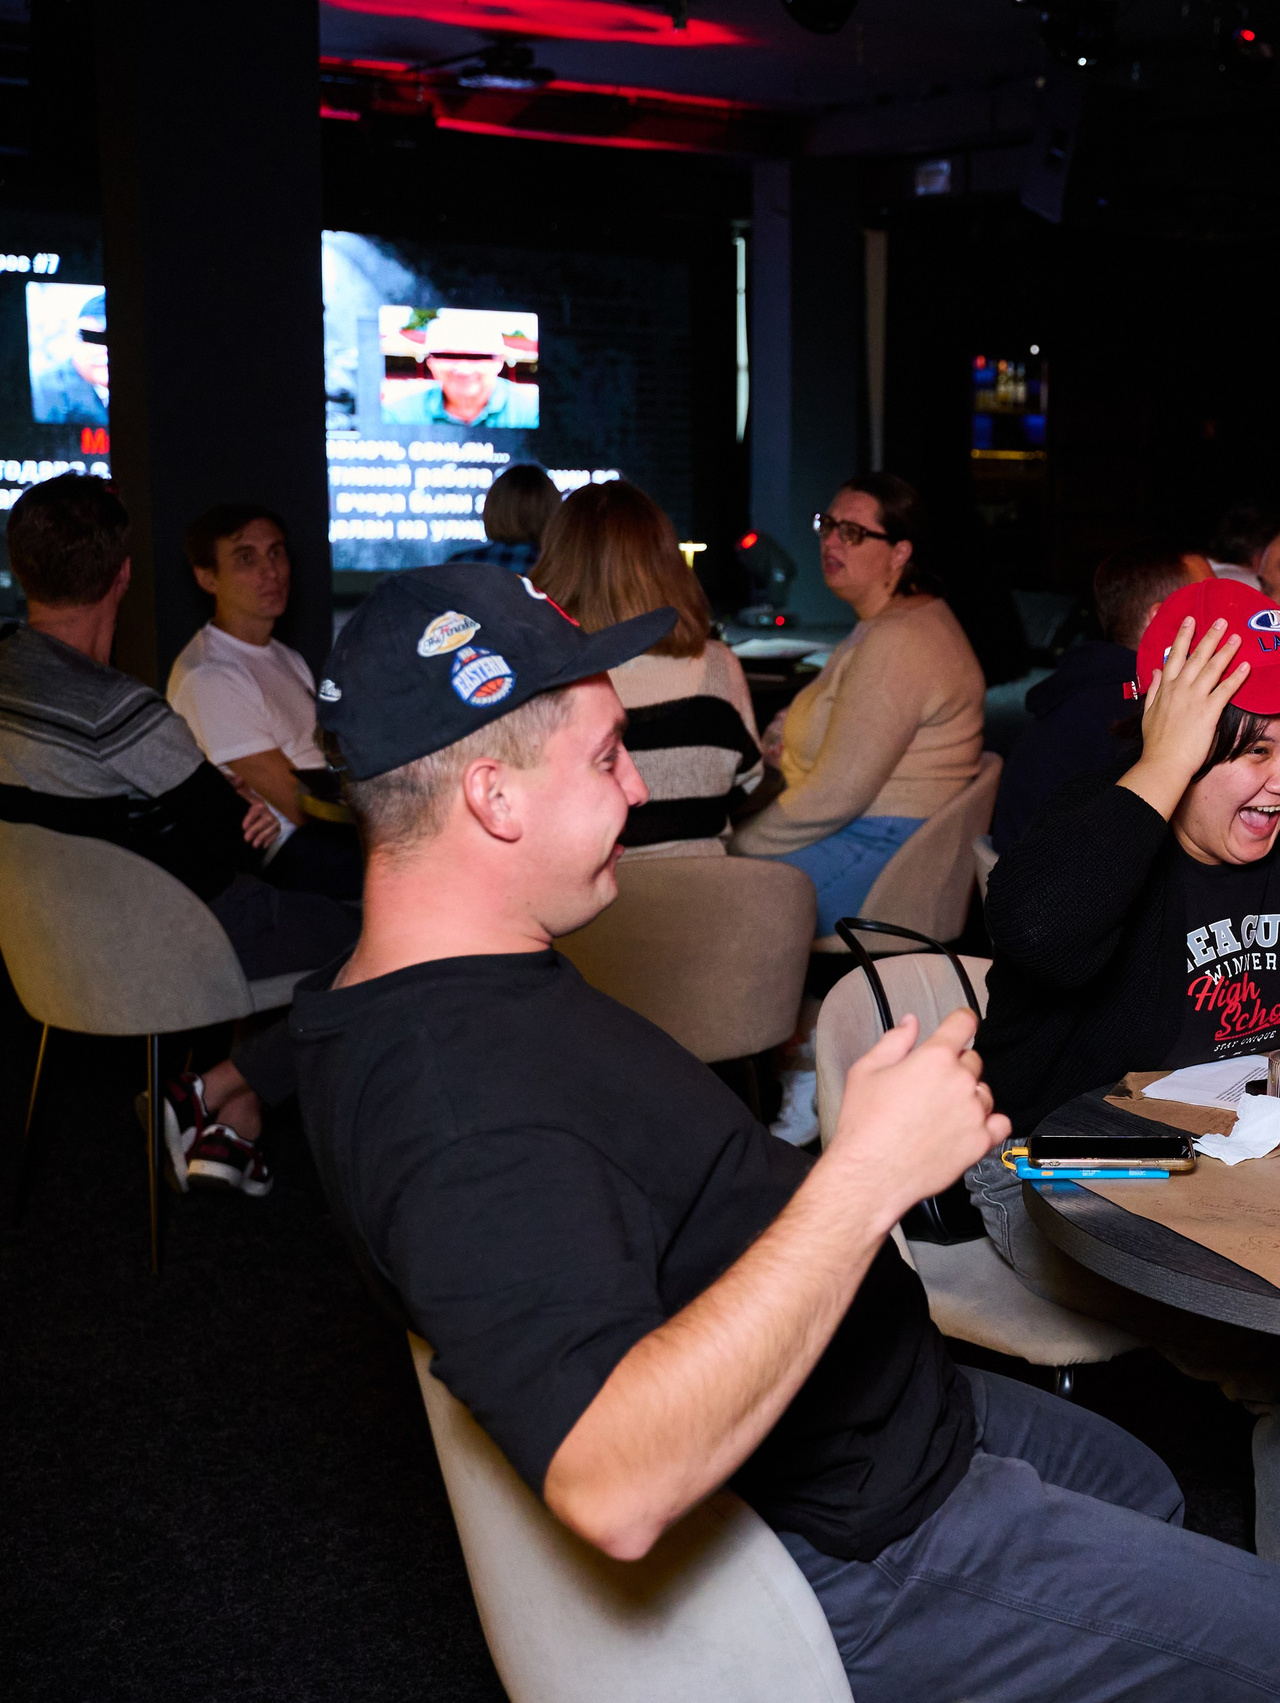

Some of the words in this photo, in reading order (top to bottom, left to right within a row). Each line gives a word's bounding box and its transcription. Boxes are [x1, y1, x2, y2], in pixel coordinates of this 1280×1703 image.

[81, 427, 110, 454] М
[440, 617, 478, 638] Finals
[452, 655, 512, 700] EASTERN
[1205, 952, 1277, 986] WINNER
[1187, 973, 1261, 1012] High
[1213, 1040, 1239, 1052] STAY
[1240, 1030, 1277, 1045] UNIQUE
